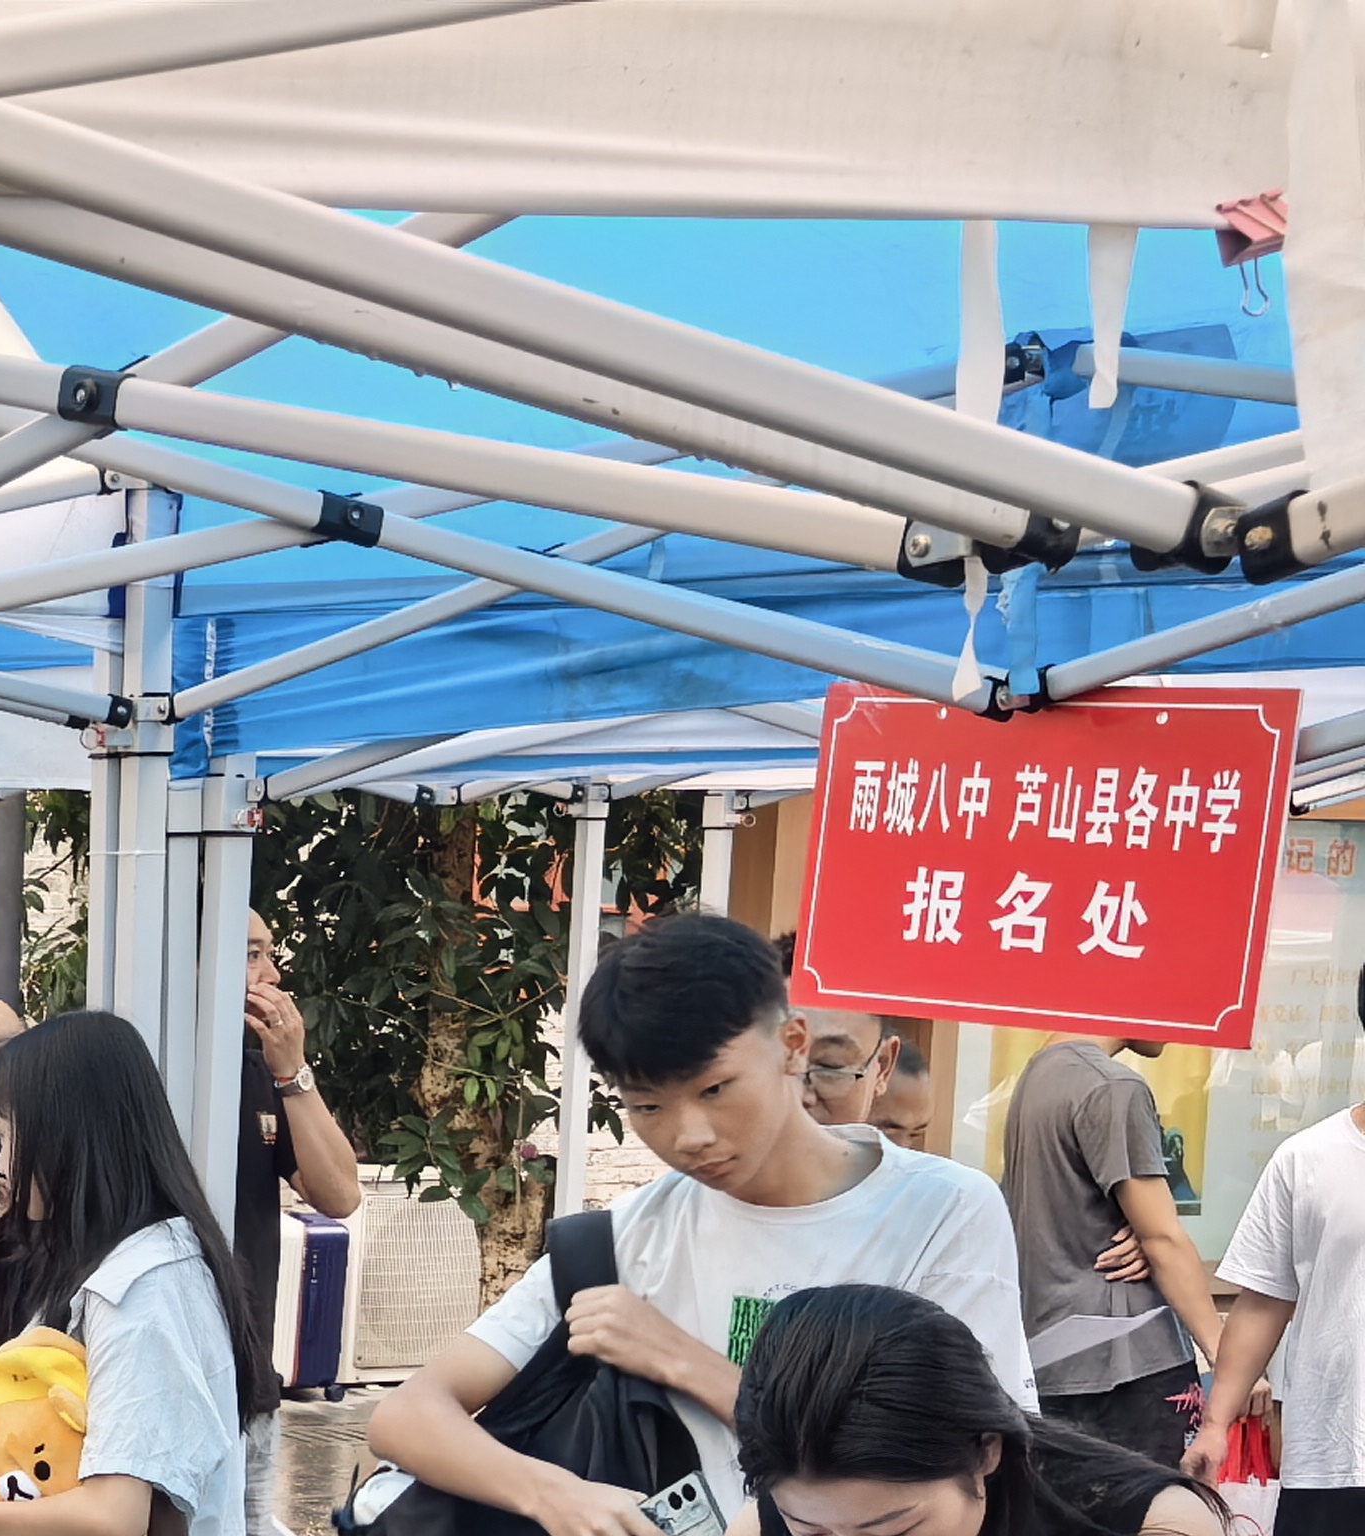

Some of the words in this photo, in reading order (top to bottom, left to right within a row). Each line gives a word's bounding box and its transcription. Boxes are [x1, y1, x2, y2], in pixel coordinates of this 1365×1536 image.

[848, 758, 991, 840] 雨城八中
[1007, 763, 1243, 854] 芦山县各中学
[901, 866, 1148, 959] 报名处
